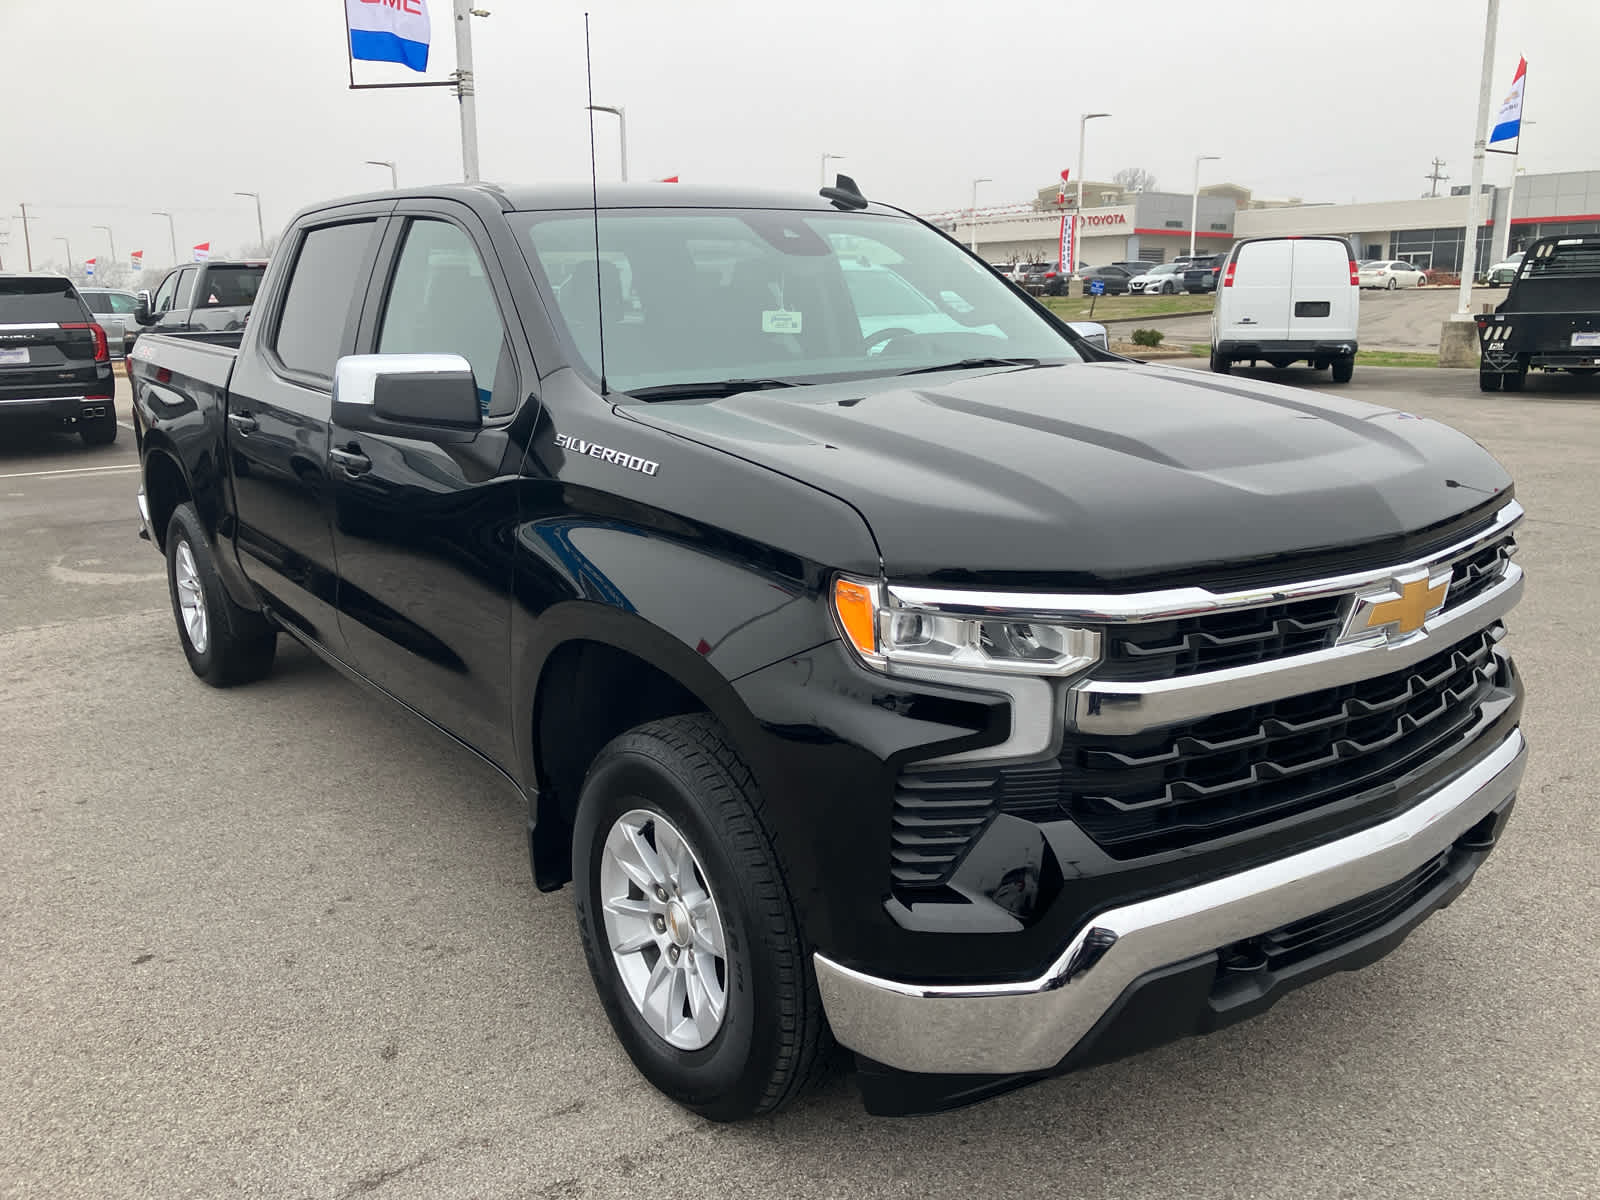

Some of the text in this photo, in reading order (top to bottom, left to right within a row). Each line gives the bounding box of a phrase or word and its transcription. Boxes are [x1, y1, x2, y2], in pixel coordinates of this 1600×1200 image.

[360, 0, 422, 15] MC
[1088, 213, 1126, 226] TOYOTA
[553, 433, 659, 475] SILVERADO
